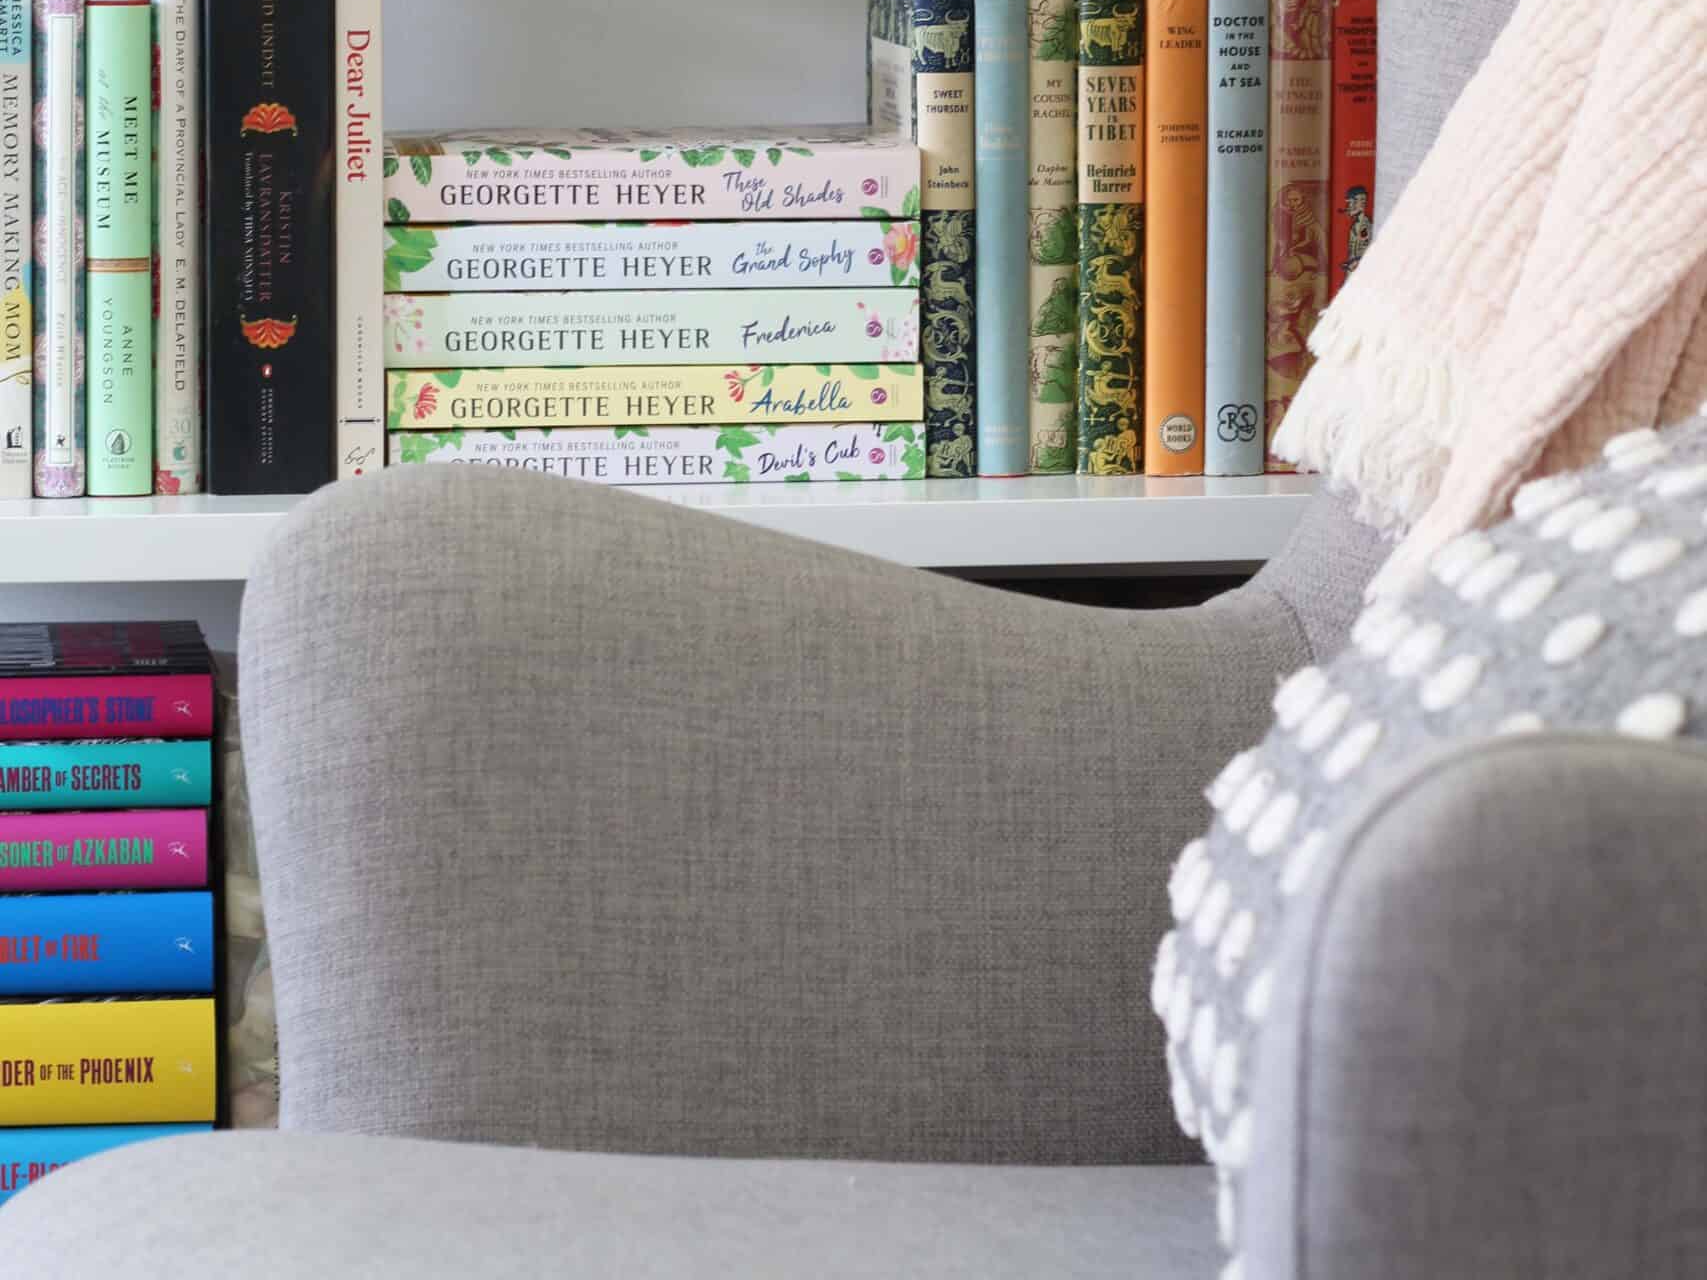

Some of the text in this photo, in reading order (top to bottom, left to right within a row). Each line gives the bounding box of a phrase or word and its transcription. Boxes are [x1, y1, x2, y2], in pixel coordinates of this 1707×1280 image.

[1213, 16, 1264, 27] DOCTOR
[1236, 31, 1254, 41] THE
[174, 29, 186, 73] DIARY
[262, 23, 274, 86] UNDSET
[1218, 46, 1261, 57] HOUSE
[1230, 63, 1250, 71] AND
[174, 78, 186, 99] OF
[933, 89, 963, 99] SWEET
[1085, 76, 1136, 93] SEVEN
[1218, 77, 1262, 88] AT SEA
[174, 104, 186, 112] A
[346, 30, 371, 181] Dear Juliet
[925, 103, 968, 114] THURSDAY
[1087, 96, 1136, 113] YEARS
[1086, 124, 1136, 141] TIBET
[1216, 128, 1263, 140] RICHARD
[124, 97, 137, 203] MEET ME
[1217, 144, 1263, 154] GORDON
[174, 118, 186, 205] PROVINCIAL
[1086, 163, 1137, 178] Heinrich
[465, 168, 672, 180] NEW YORK TIMES BESTSELLING AUTHOR
[723, 171, 766, 198] These
[441, 185, 704, 205] GEORGETTE HEYER
[1092, 179, 1133, 193] Harrer
[3, 75, 20, 361] MEMORY MAKING MOM
[174, 210, 186, 248] LADY
[280, 192, 292, 264] KRISTIN
[448, 256, 711, 279] GEORGETTE HEYER
[733, 240, 854, 274] Grand Sophy
[445, 329, 709, 352] GEORGETTE HEYER
[742, 320, 835, 347] Frederica
[101, 296, 114, 404] YOUNGSON
[121, 325, 133, 377] ANNE
[174, 299, 186, 392] DELAFIELD
[451, 396, 714, 419] GEORGETTE HEYER
[750, 382, 852, 415] Arabella
[626, 456, 712, 476] HEYER
[758, 436, 859, 476] Devil's Cub
[70, 762, 142, 791] SECRETS
[71, 837, 154, 868] AZKABAN
[39, 1062, 53, 1081] OF
[56, 1062, 76, 1081] THE
[79, 1056, 155, 1086] PHOENIX
